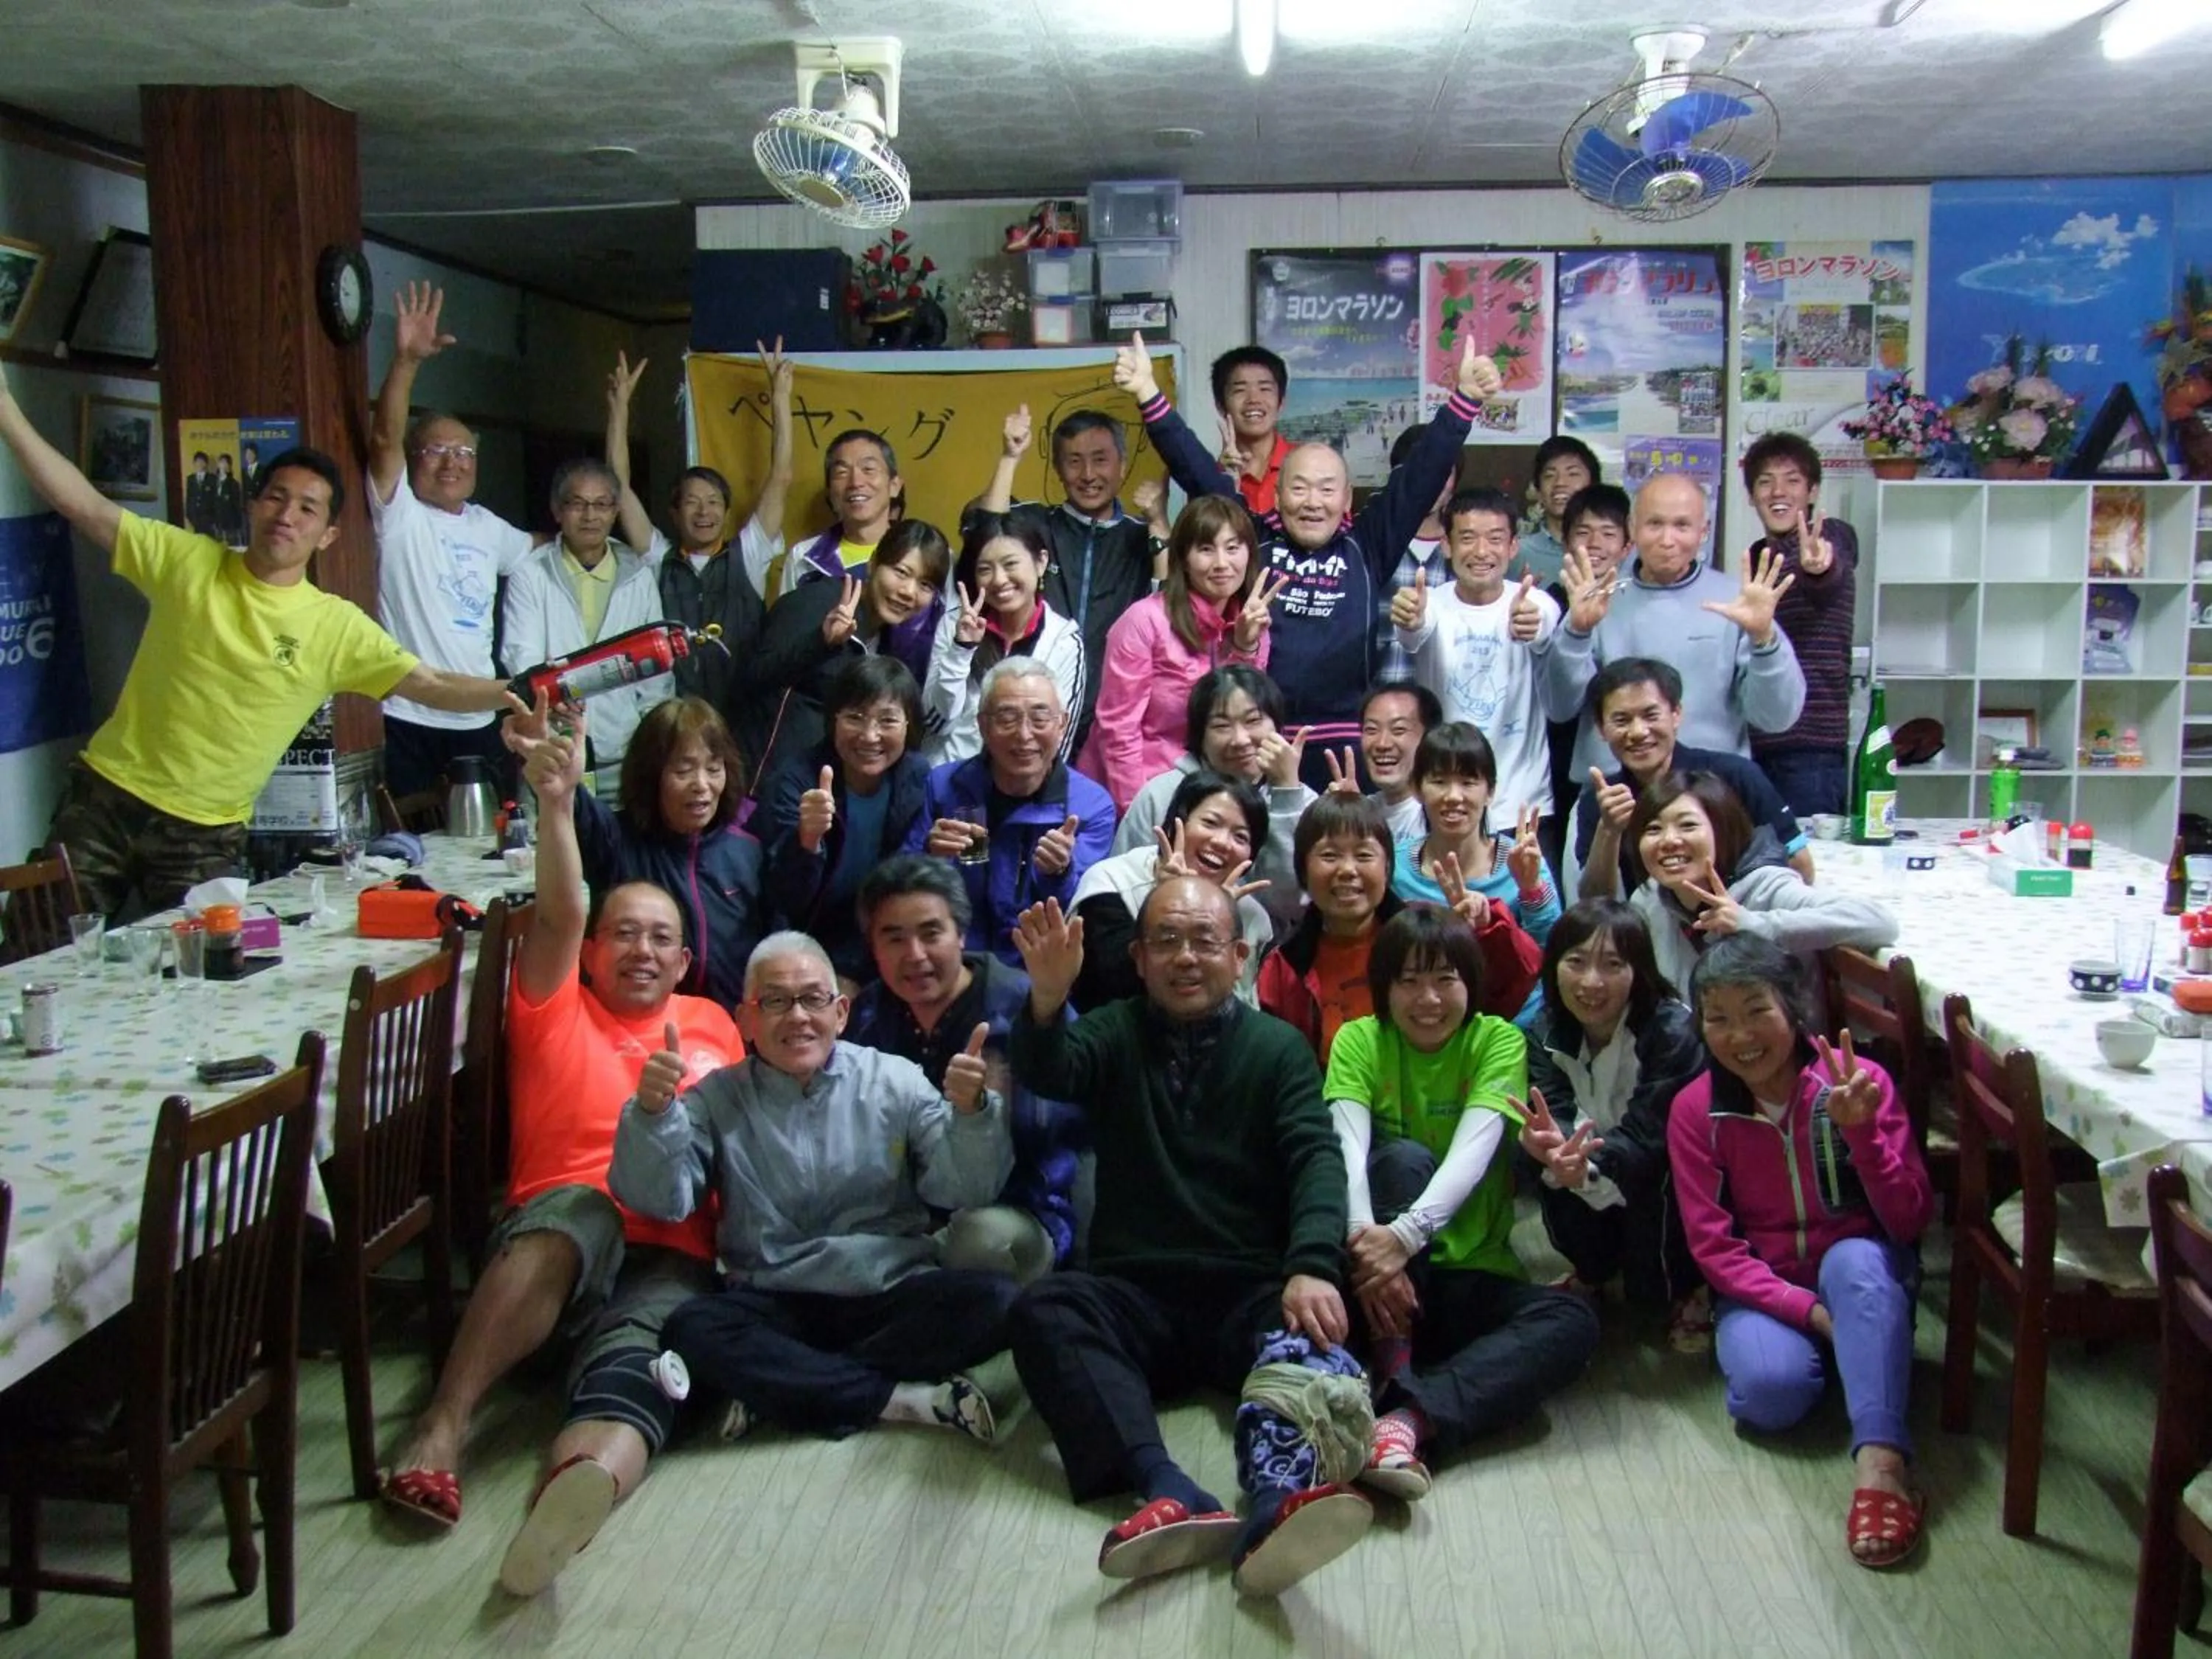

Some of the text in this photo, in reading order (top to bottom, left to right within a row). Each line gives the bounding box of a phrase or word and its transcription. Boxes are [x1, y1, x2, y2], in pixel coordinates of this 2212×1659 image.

[1753, 255, 1902, 283] ヨロンマラソン
[1285, 293, 1404, 321] ヨロンマラソン
[278, 748, 336, 767] PECT
